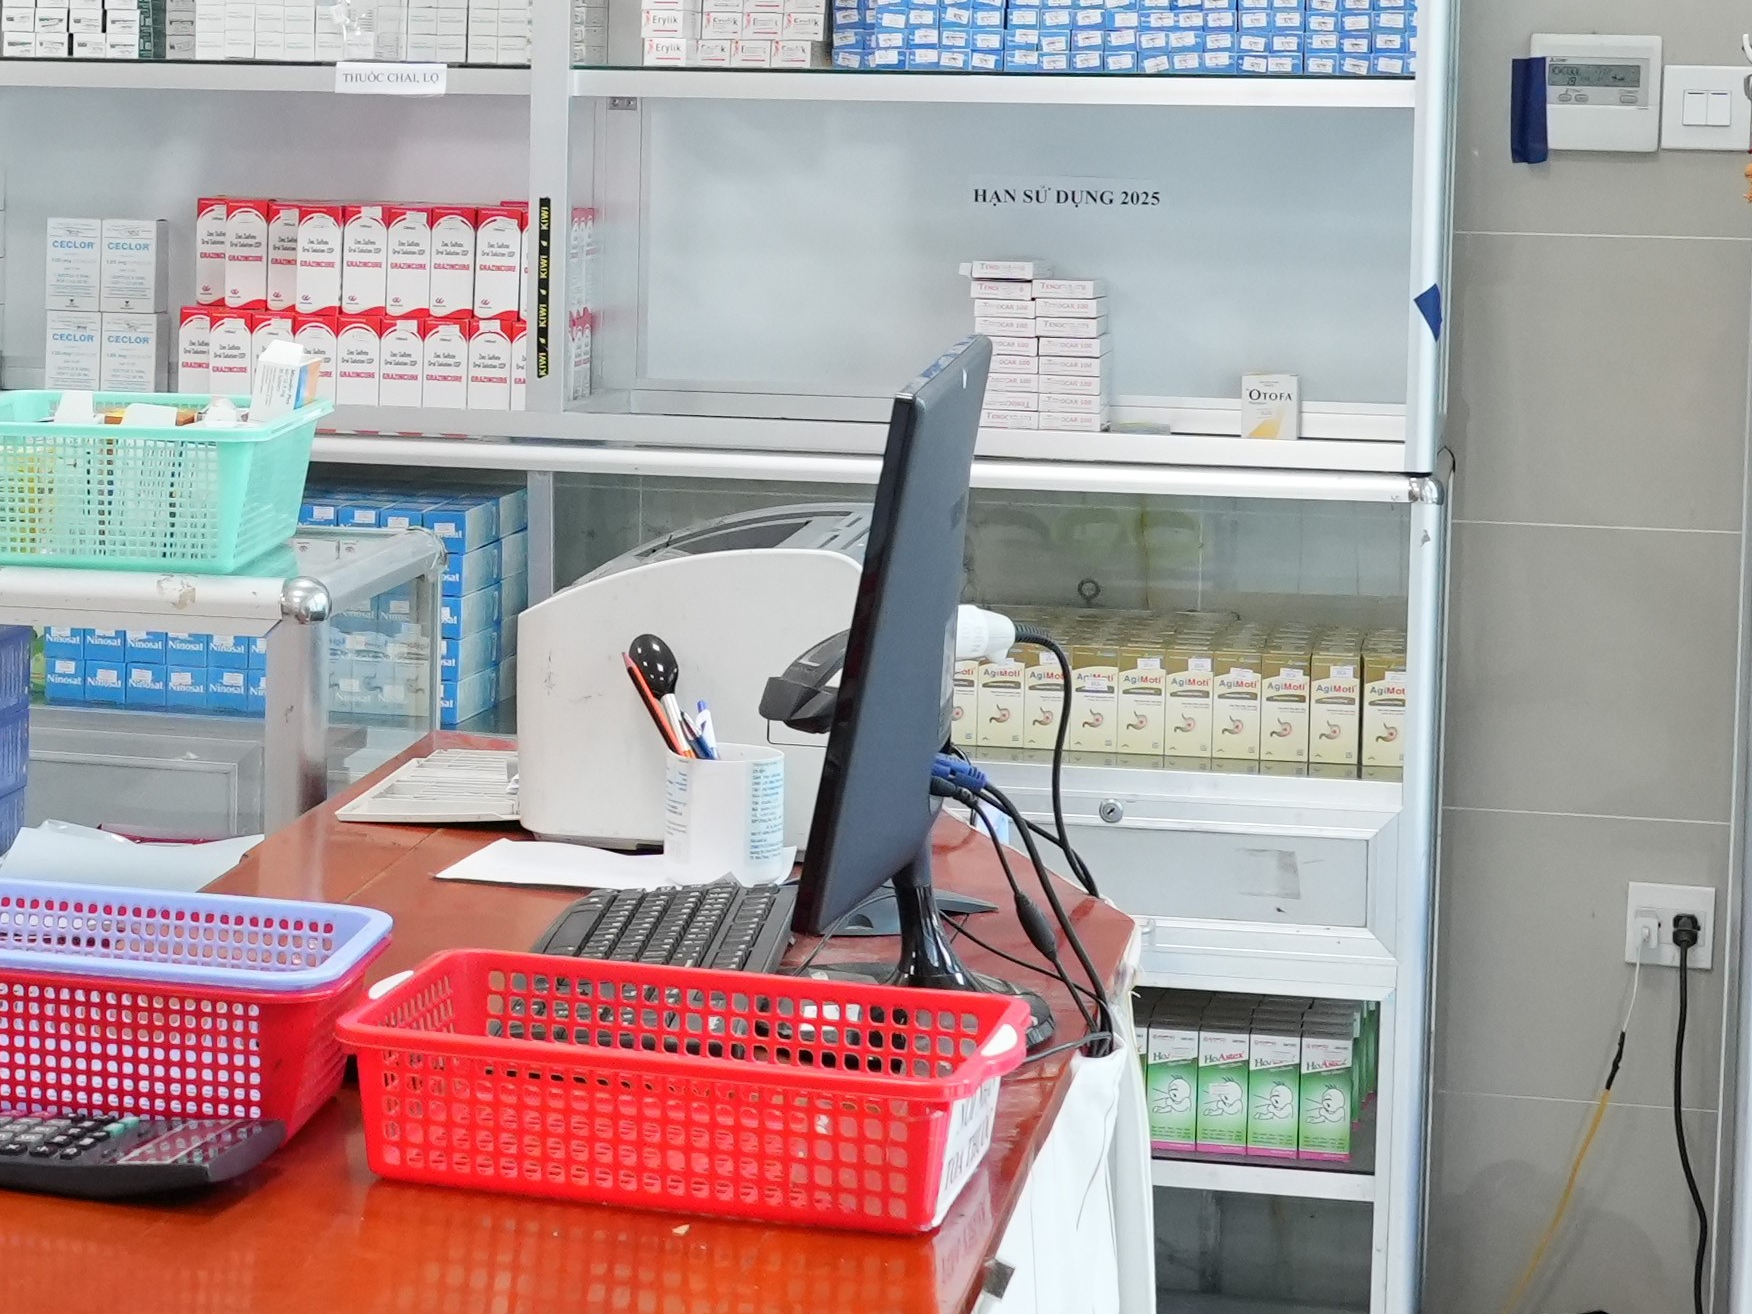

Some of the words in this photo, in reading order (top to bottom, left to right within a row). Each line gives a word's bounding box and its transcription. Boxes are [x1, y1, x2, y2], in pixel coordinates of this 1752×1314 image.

[343, 71, 384, 83] THUỐC
[423, 73, 439, 84] LỌ
[973, 189, 1016, 207] HẠN
[1023, 185, 1052, 204] SỬ
[1056, 189, 1114, 209] DỤNG
[1121, 191, 1161, 206] 2025
[540, 206, 549, 230] KIWI
[52, 239, 94, 249] CECLOR
[107, 241, 149, 251] CECLOR
[52, 333, 94, 343] CECLOR
[1249, 388, 1293, 402] OTOFA
[1123, 674, 1164, 685] AgiMoti
[1218, 678, 1259, 689] AgiMoti
[1266, 681, 1307, 692] AgiMoti
[1315, 683, 1356, 694] AgiMoti
